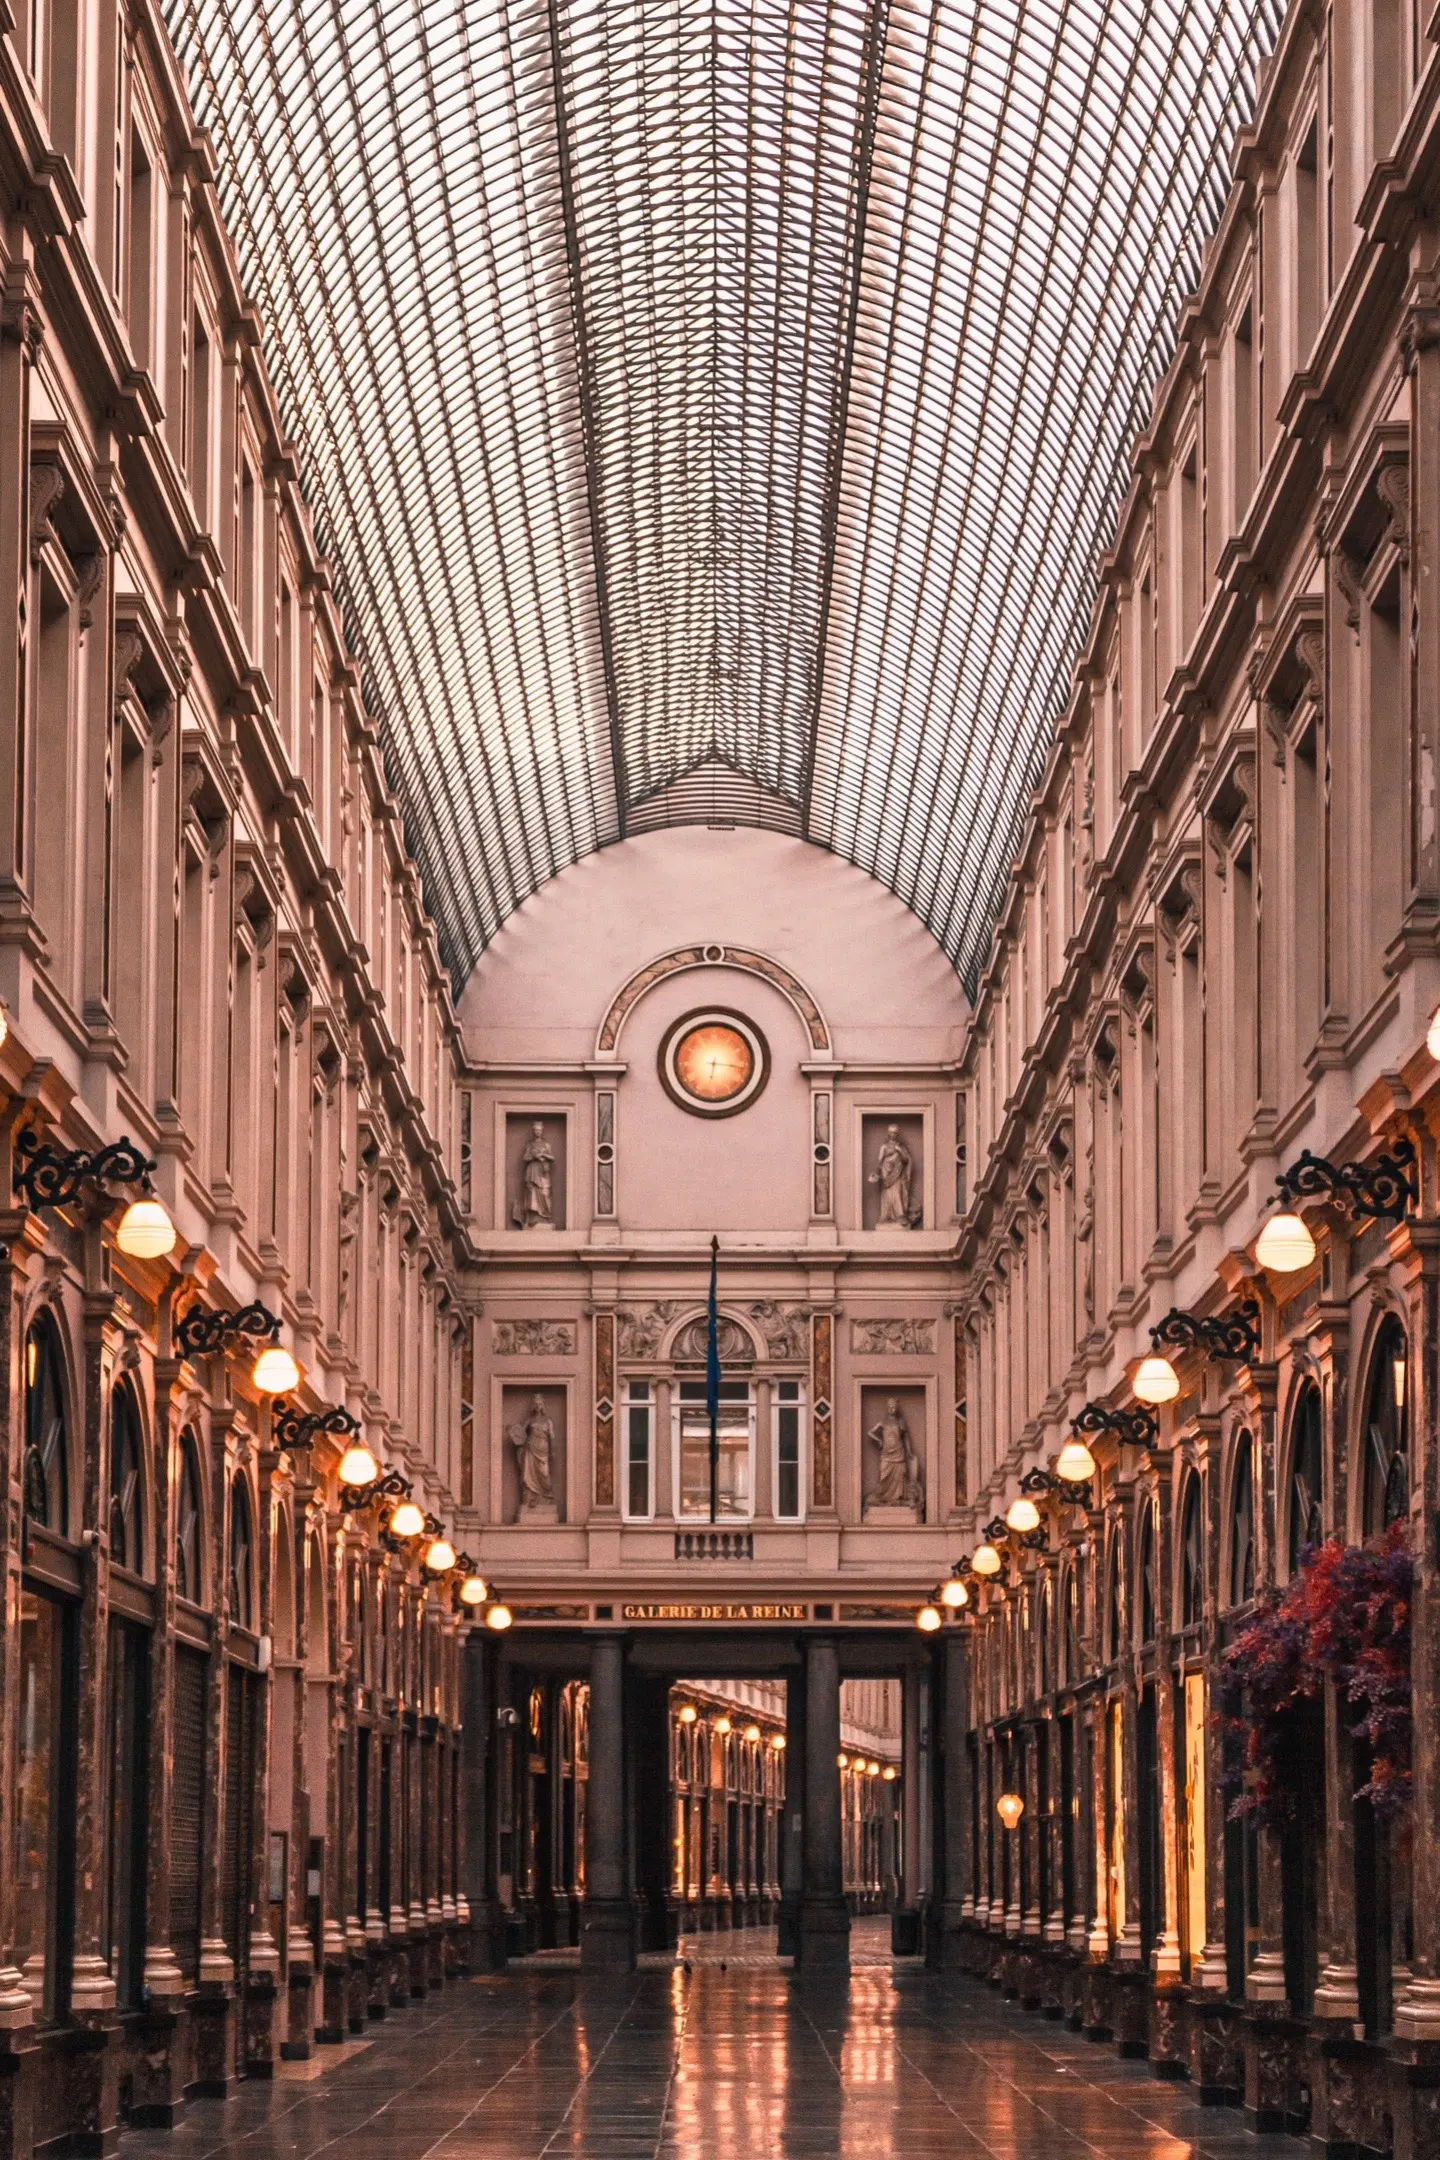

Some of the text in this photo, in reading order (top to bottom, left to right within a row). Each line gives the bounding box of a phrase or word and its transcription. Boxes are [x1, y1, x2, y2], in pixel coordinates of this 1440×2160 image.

[624, 1605, 806, 1619] GALERIE DE LA REINE
